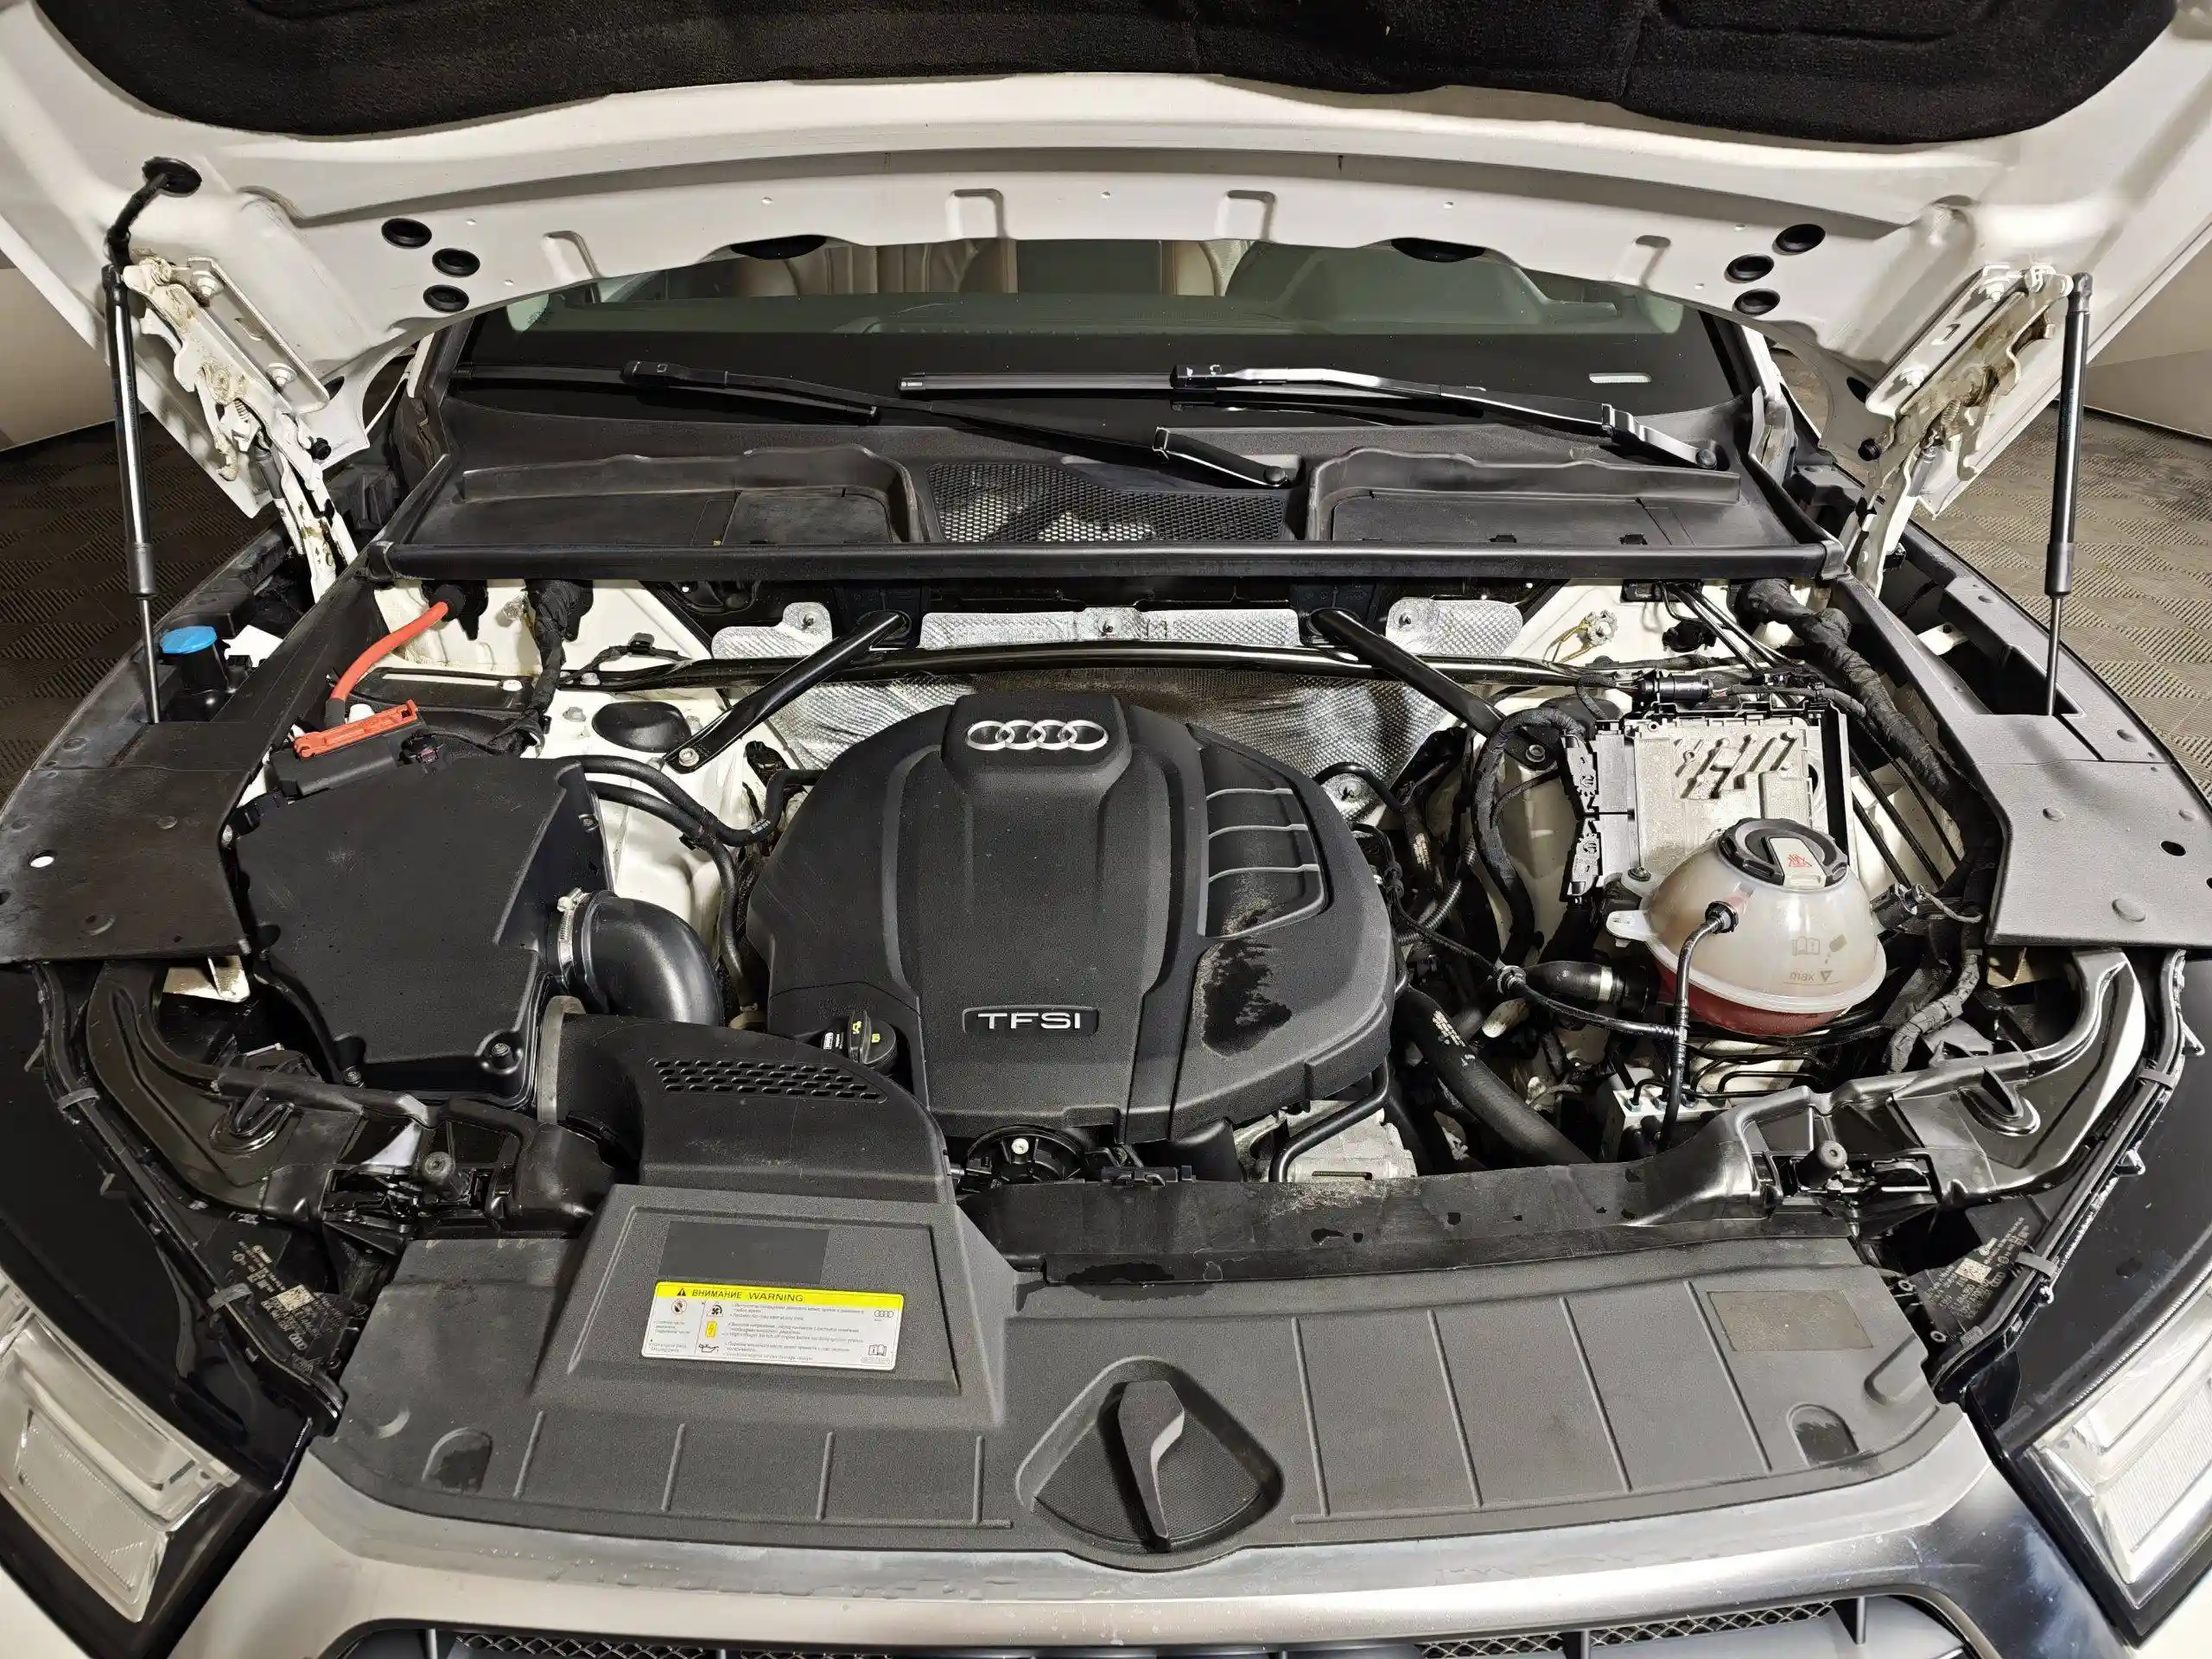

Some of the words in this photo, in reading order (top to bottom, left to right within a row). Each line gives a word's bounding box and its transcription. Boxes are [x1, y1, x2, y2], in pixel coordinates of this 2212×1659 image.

[1789, 971, 1815, 982] max
[977, 1012, 1081, 1030] TFSI
[691, 1288, 742, 1300] ВНИМАНИЕ
[748, 1291, 804, 1302] WARNING
